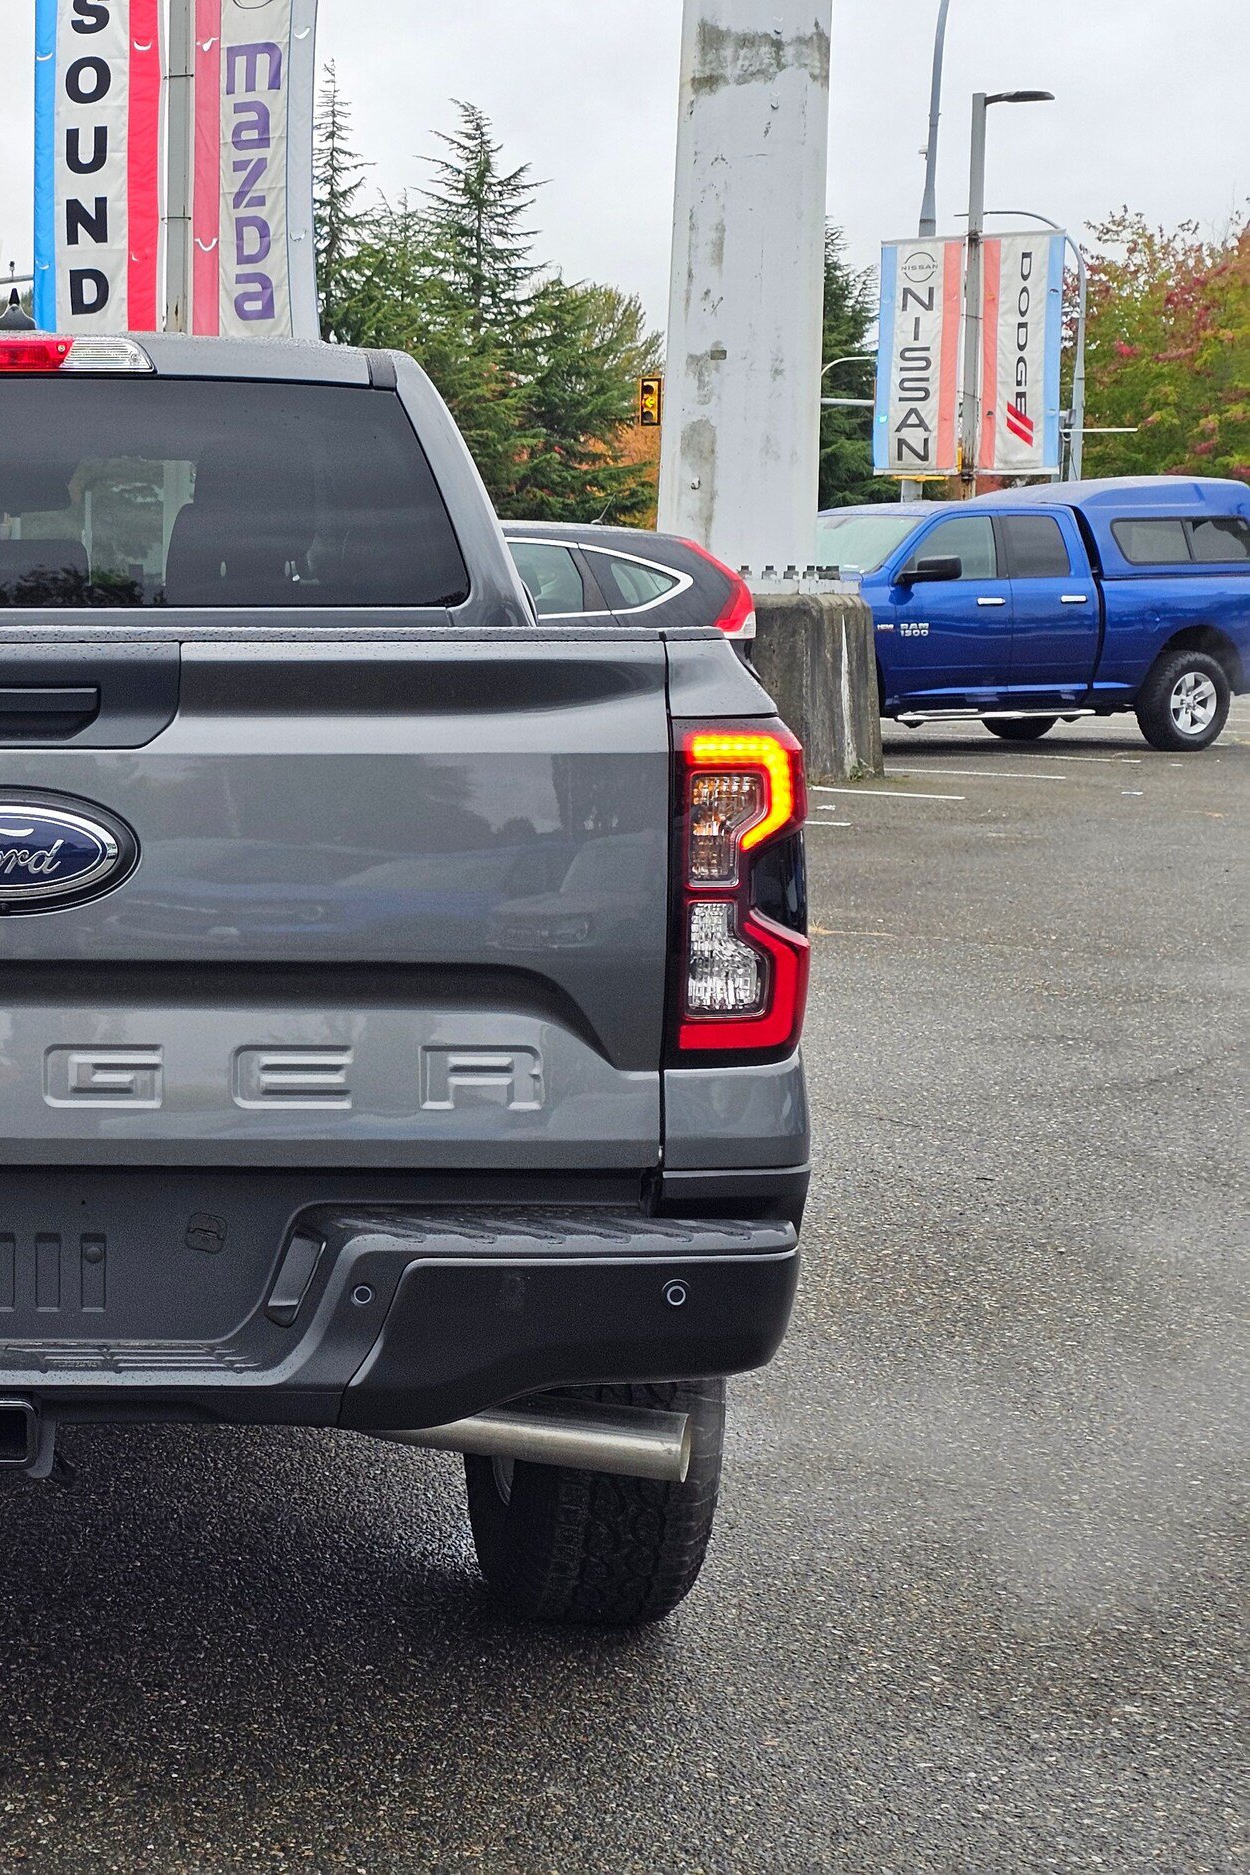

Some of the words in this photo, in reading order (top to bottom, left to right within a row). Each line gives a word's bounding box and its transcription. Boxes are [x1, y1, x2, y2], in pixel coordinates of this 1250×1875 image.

[65, 0, 111, 316] SOUND
[894, 286, 934, 462] NISSAN
[1015, 251, 1033, 416] DODGE
